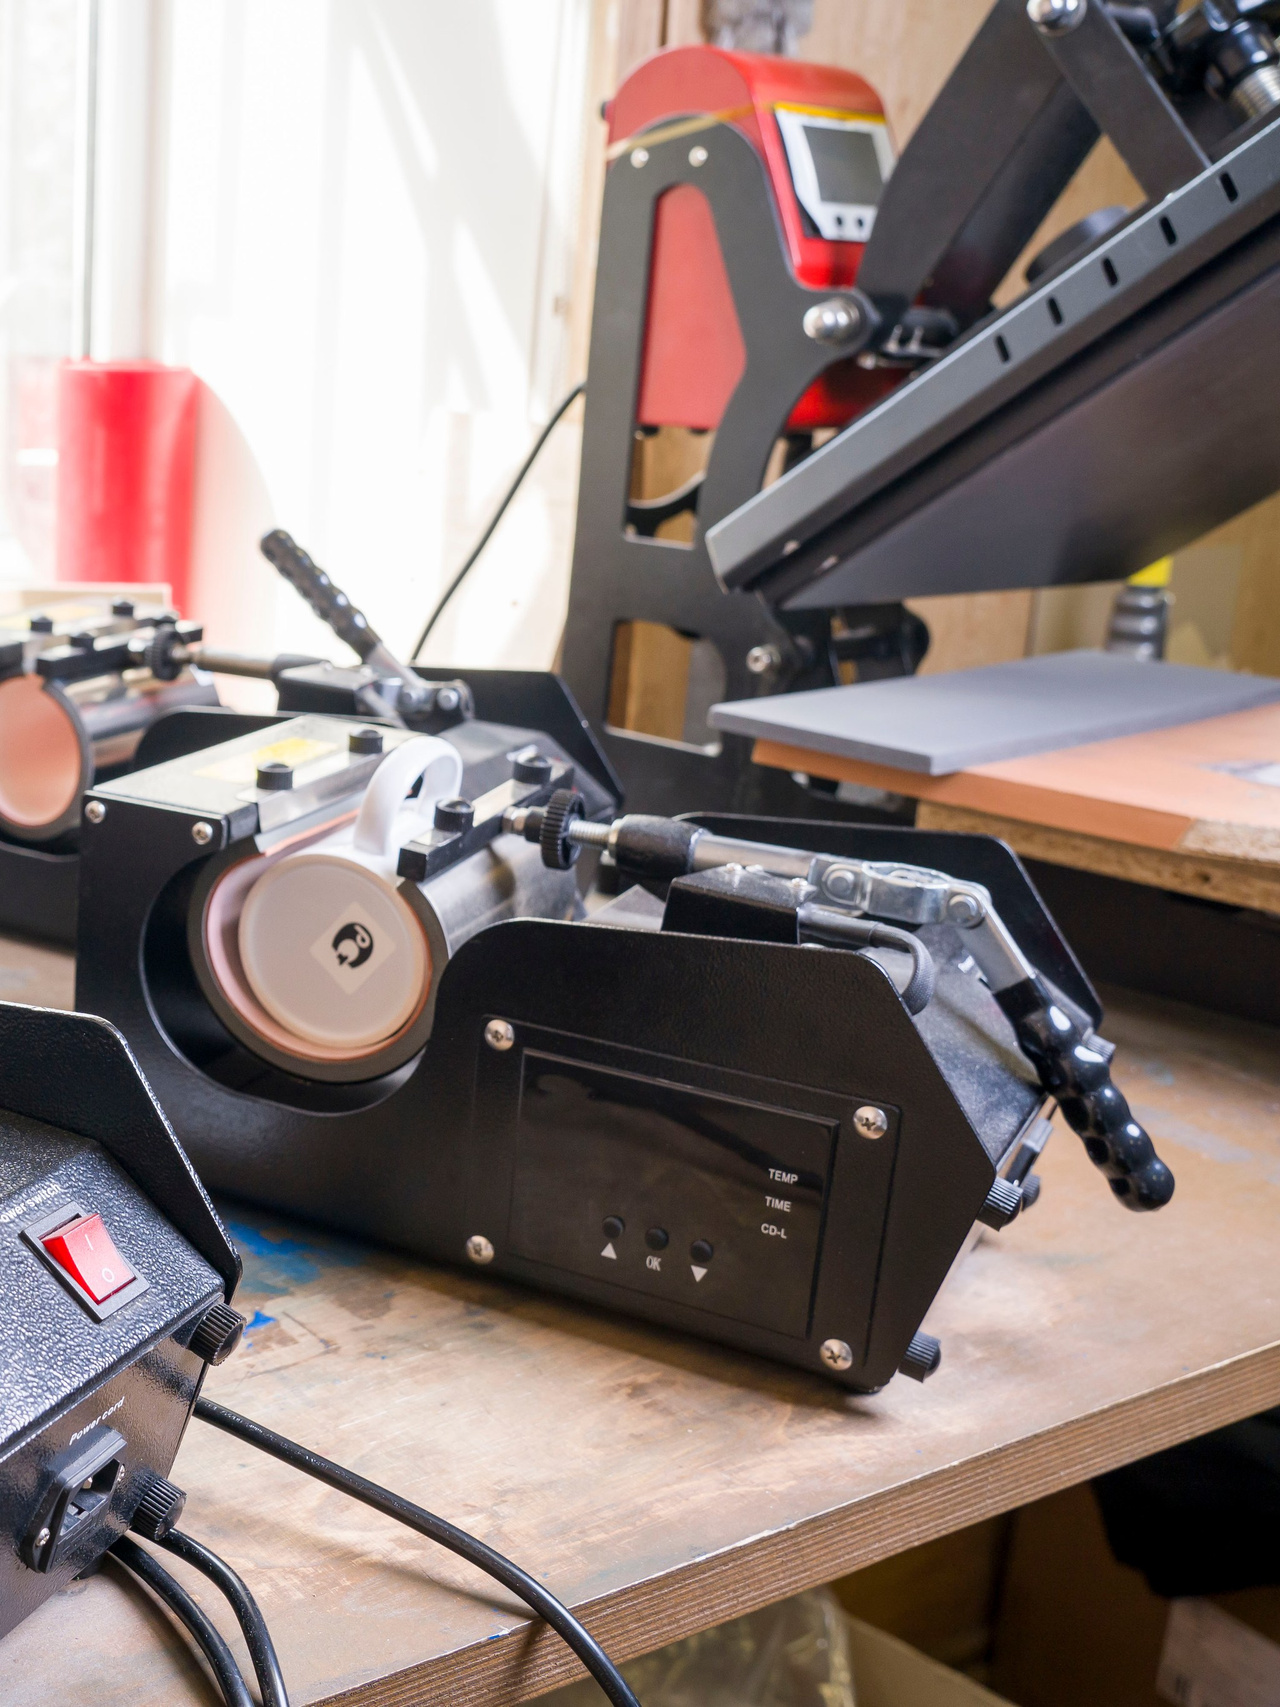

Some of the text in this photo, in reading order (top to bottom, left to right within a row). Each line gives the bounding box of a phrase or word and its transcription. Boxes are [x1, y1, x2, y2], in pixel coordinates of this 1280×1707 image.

[768, 1168, 799, 1185] TEMP
[27, 1182, 63, 1209] switch
[764, 1195, 792, 1212] TIME
[760, 1223, 788, 1239] CD-L
[645, 1255, 662, 1272] OK
[68, 1395, 125, 1446] Power cord
